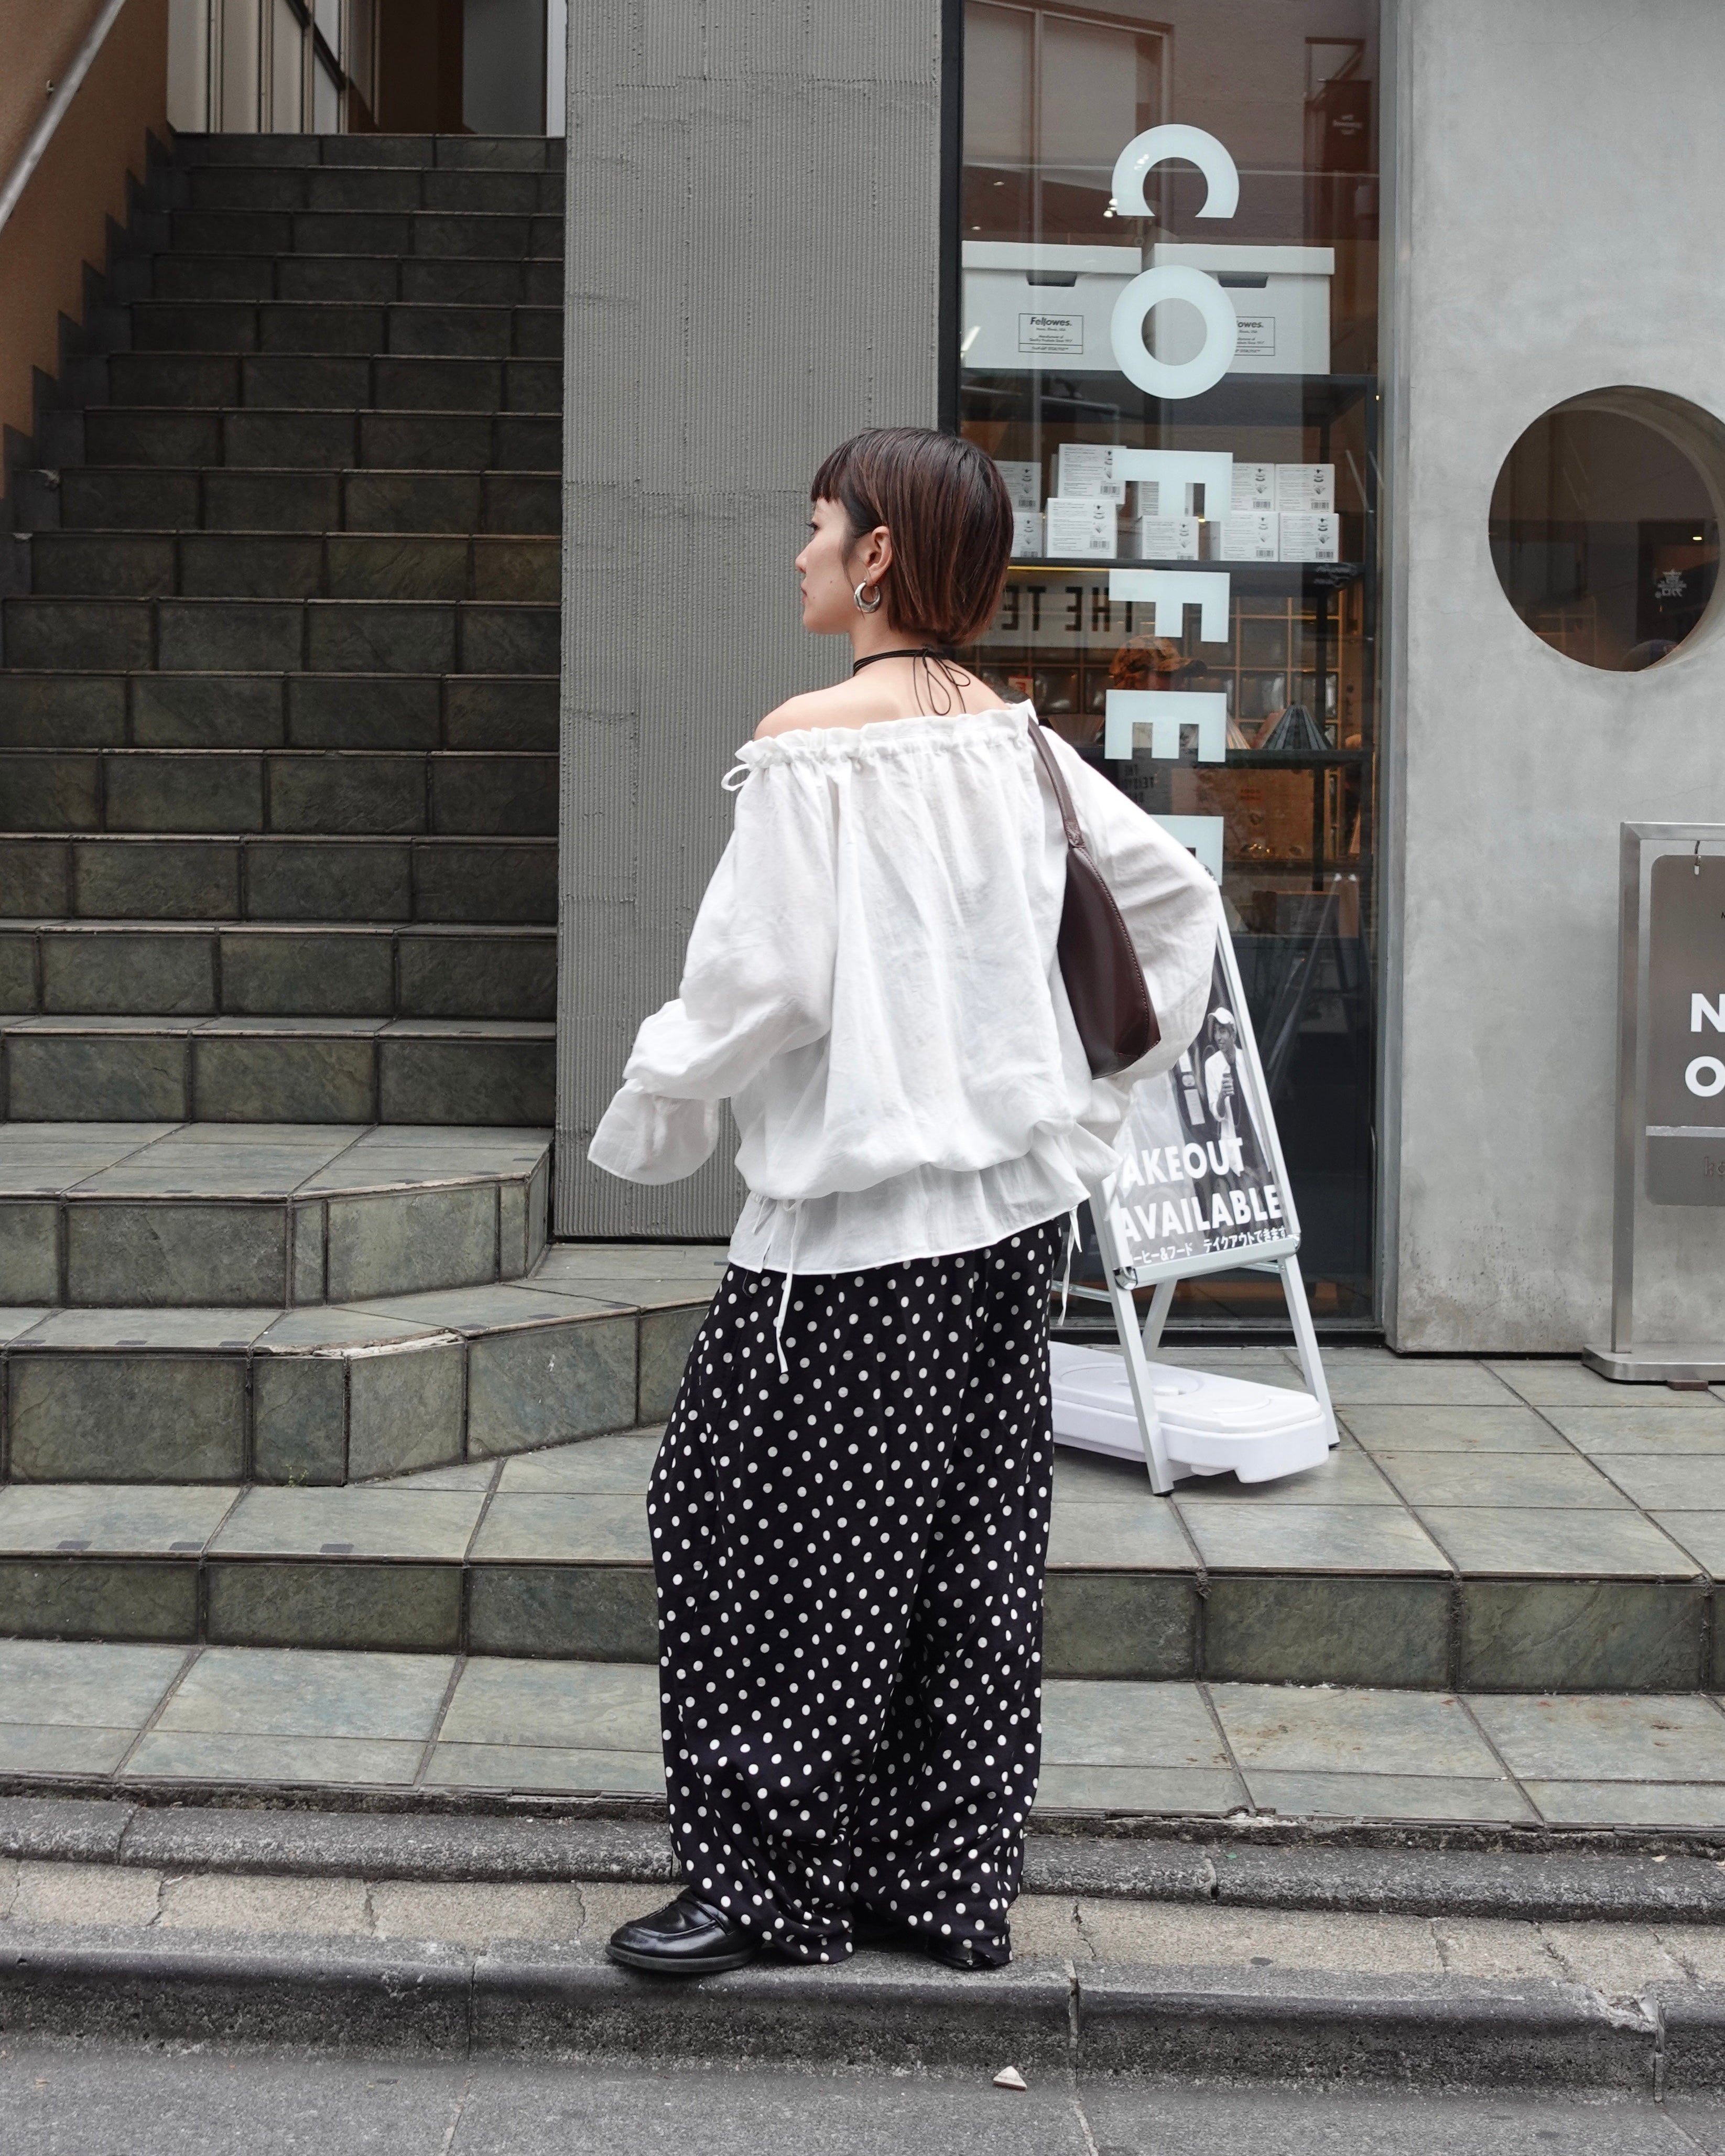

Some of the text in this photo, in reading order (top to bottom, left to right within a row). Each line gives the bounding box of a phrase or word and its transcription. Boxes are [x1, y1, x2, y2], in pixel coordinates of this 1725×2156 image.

[1122, 1137, 1244, 1189] AKEOUT
[1120, 1184, 1283, 1242] AVAILABLE
[1132, 1241, 1193, 1264] ーヒー&フード
